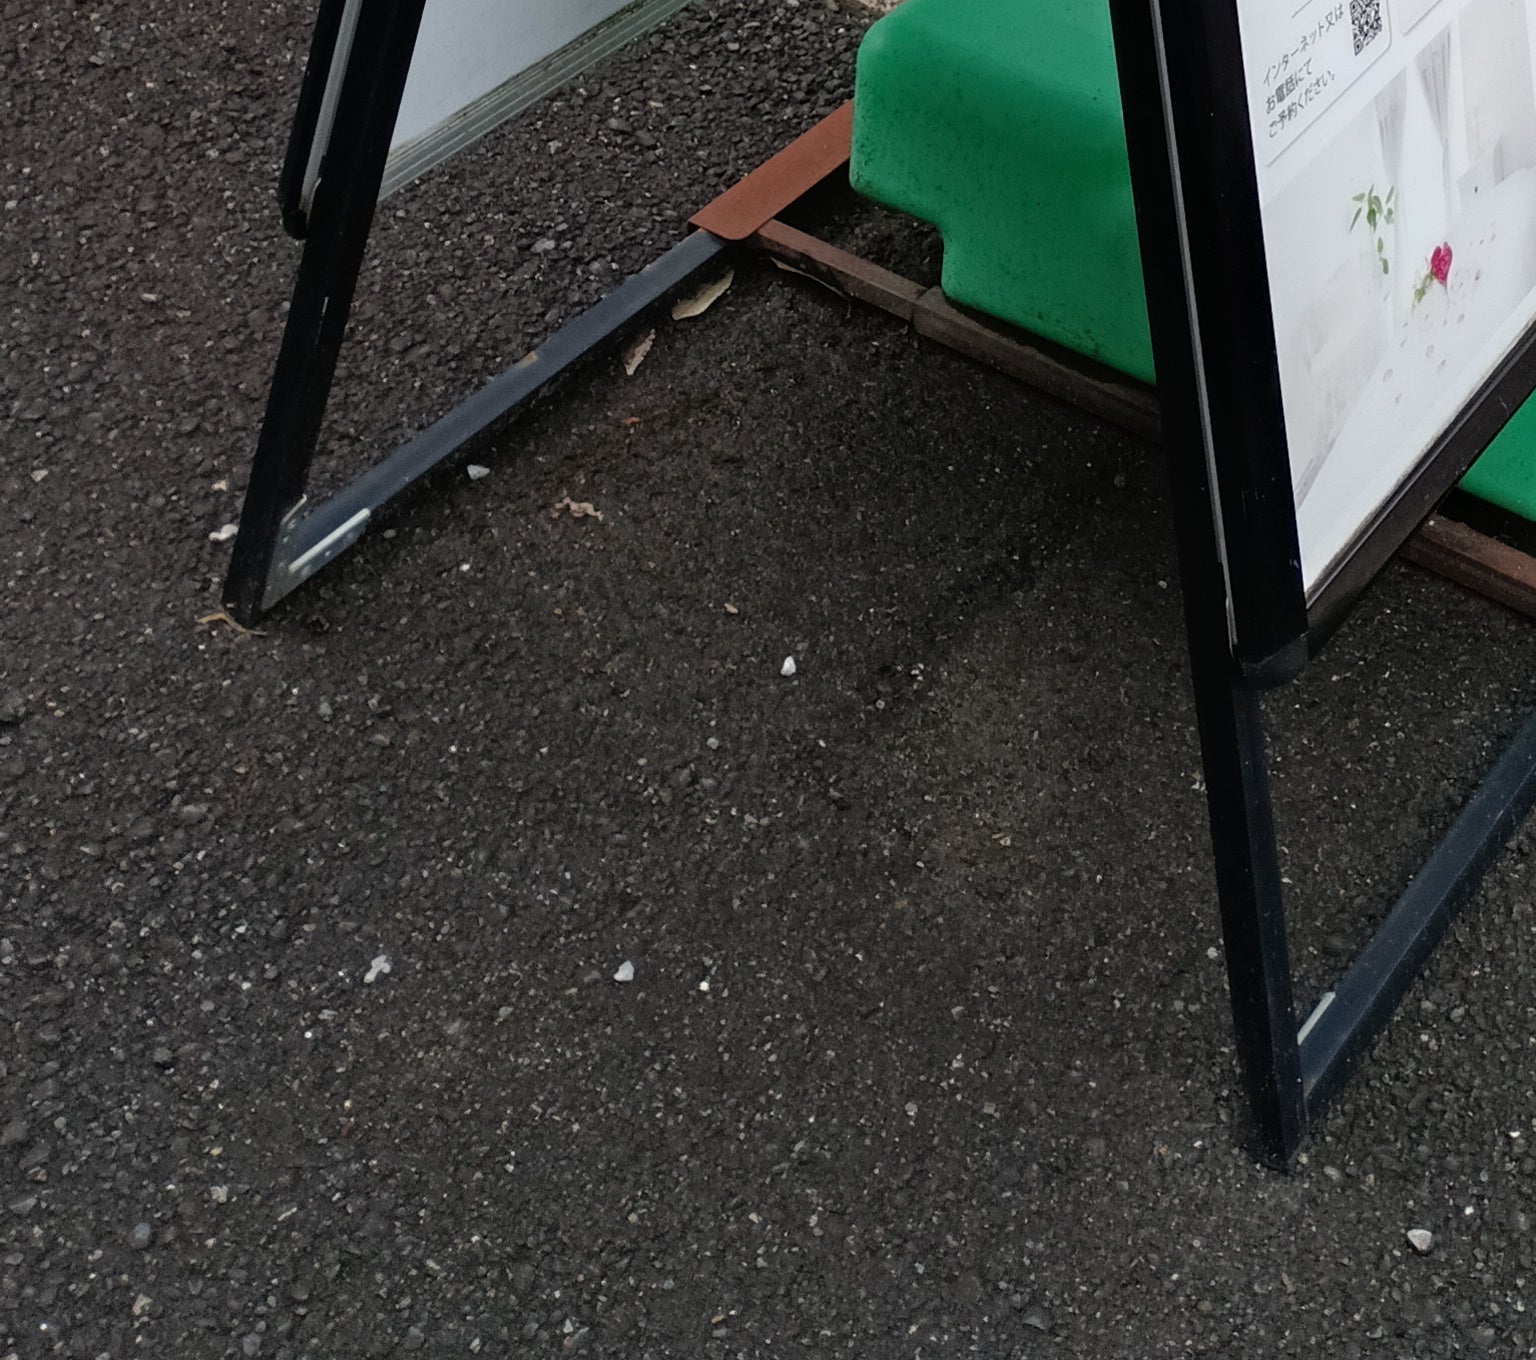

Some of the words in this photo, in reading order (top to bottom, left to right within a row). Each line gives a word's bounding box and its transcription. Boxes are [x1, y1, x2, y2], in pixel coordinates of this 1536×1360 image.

[1262, 3, 1344, 87] インターネット又は
[1265, 60, 1313, 113] お電話にて
[1268, 66, 1335, 138] ご予約ください。
